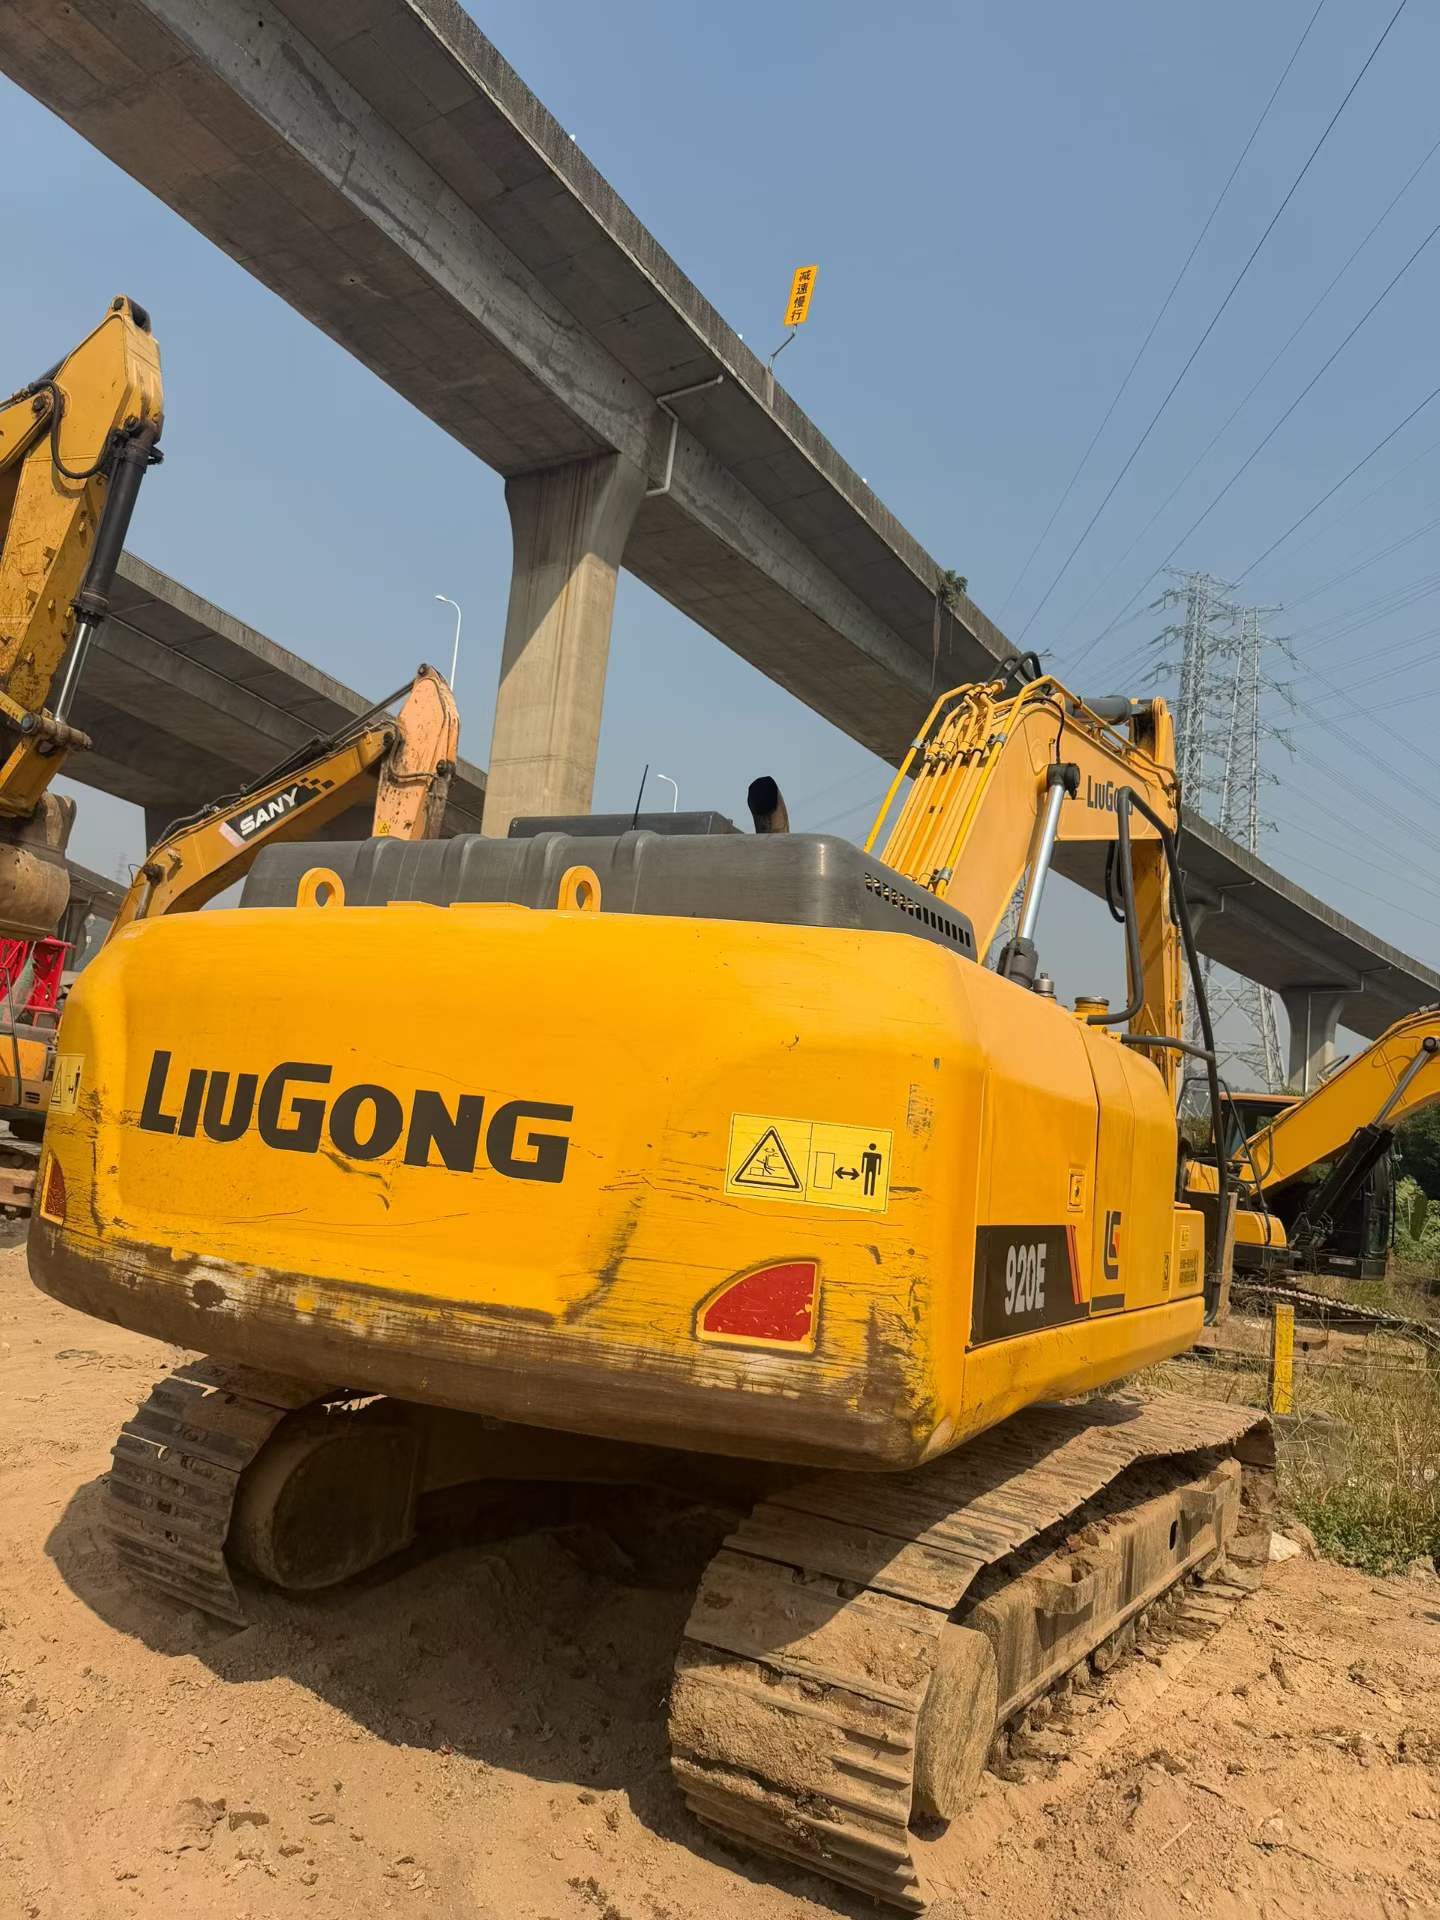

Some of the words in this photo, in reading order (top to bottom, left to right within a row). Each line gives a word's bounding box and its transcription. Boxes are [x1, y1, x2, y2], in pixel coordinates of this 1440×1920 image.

[790, 269, 812, 322] 减速慢行
[240, 786, 299, 837] SANY
[139, 1049, 575, 1184] LIUGONG
[1004, 1243, 1047, 1316] 920E
